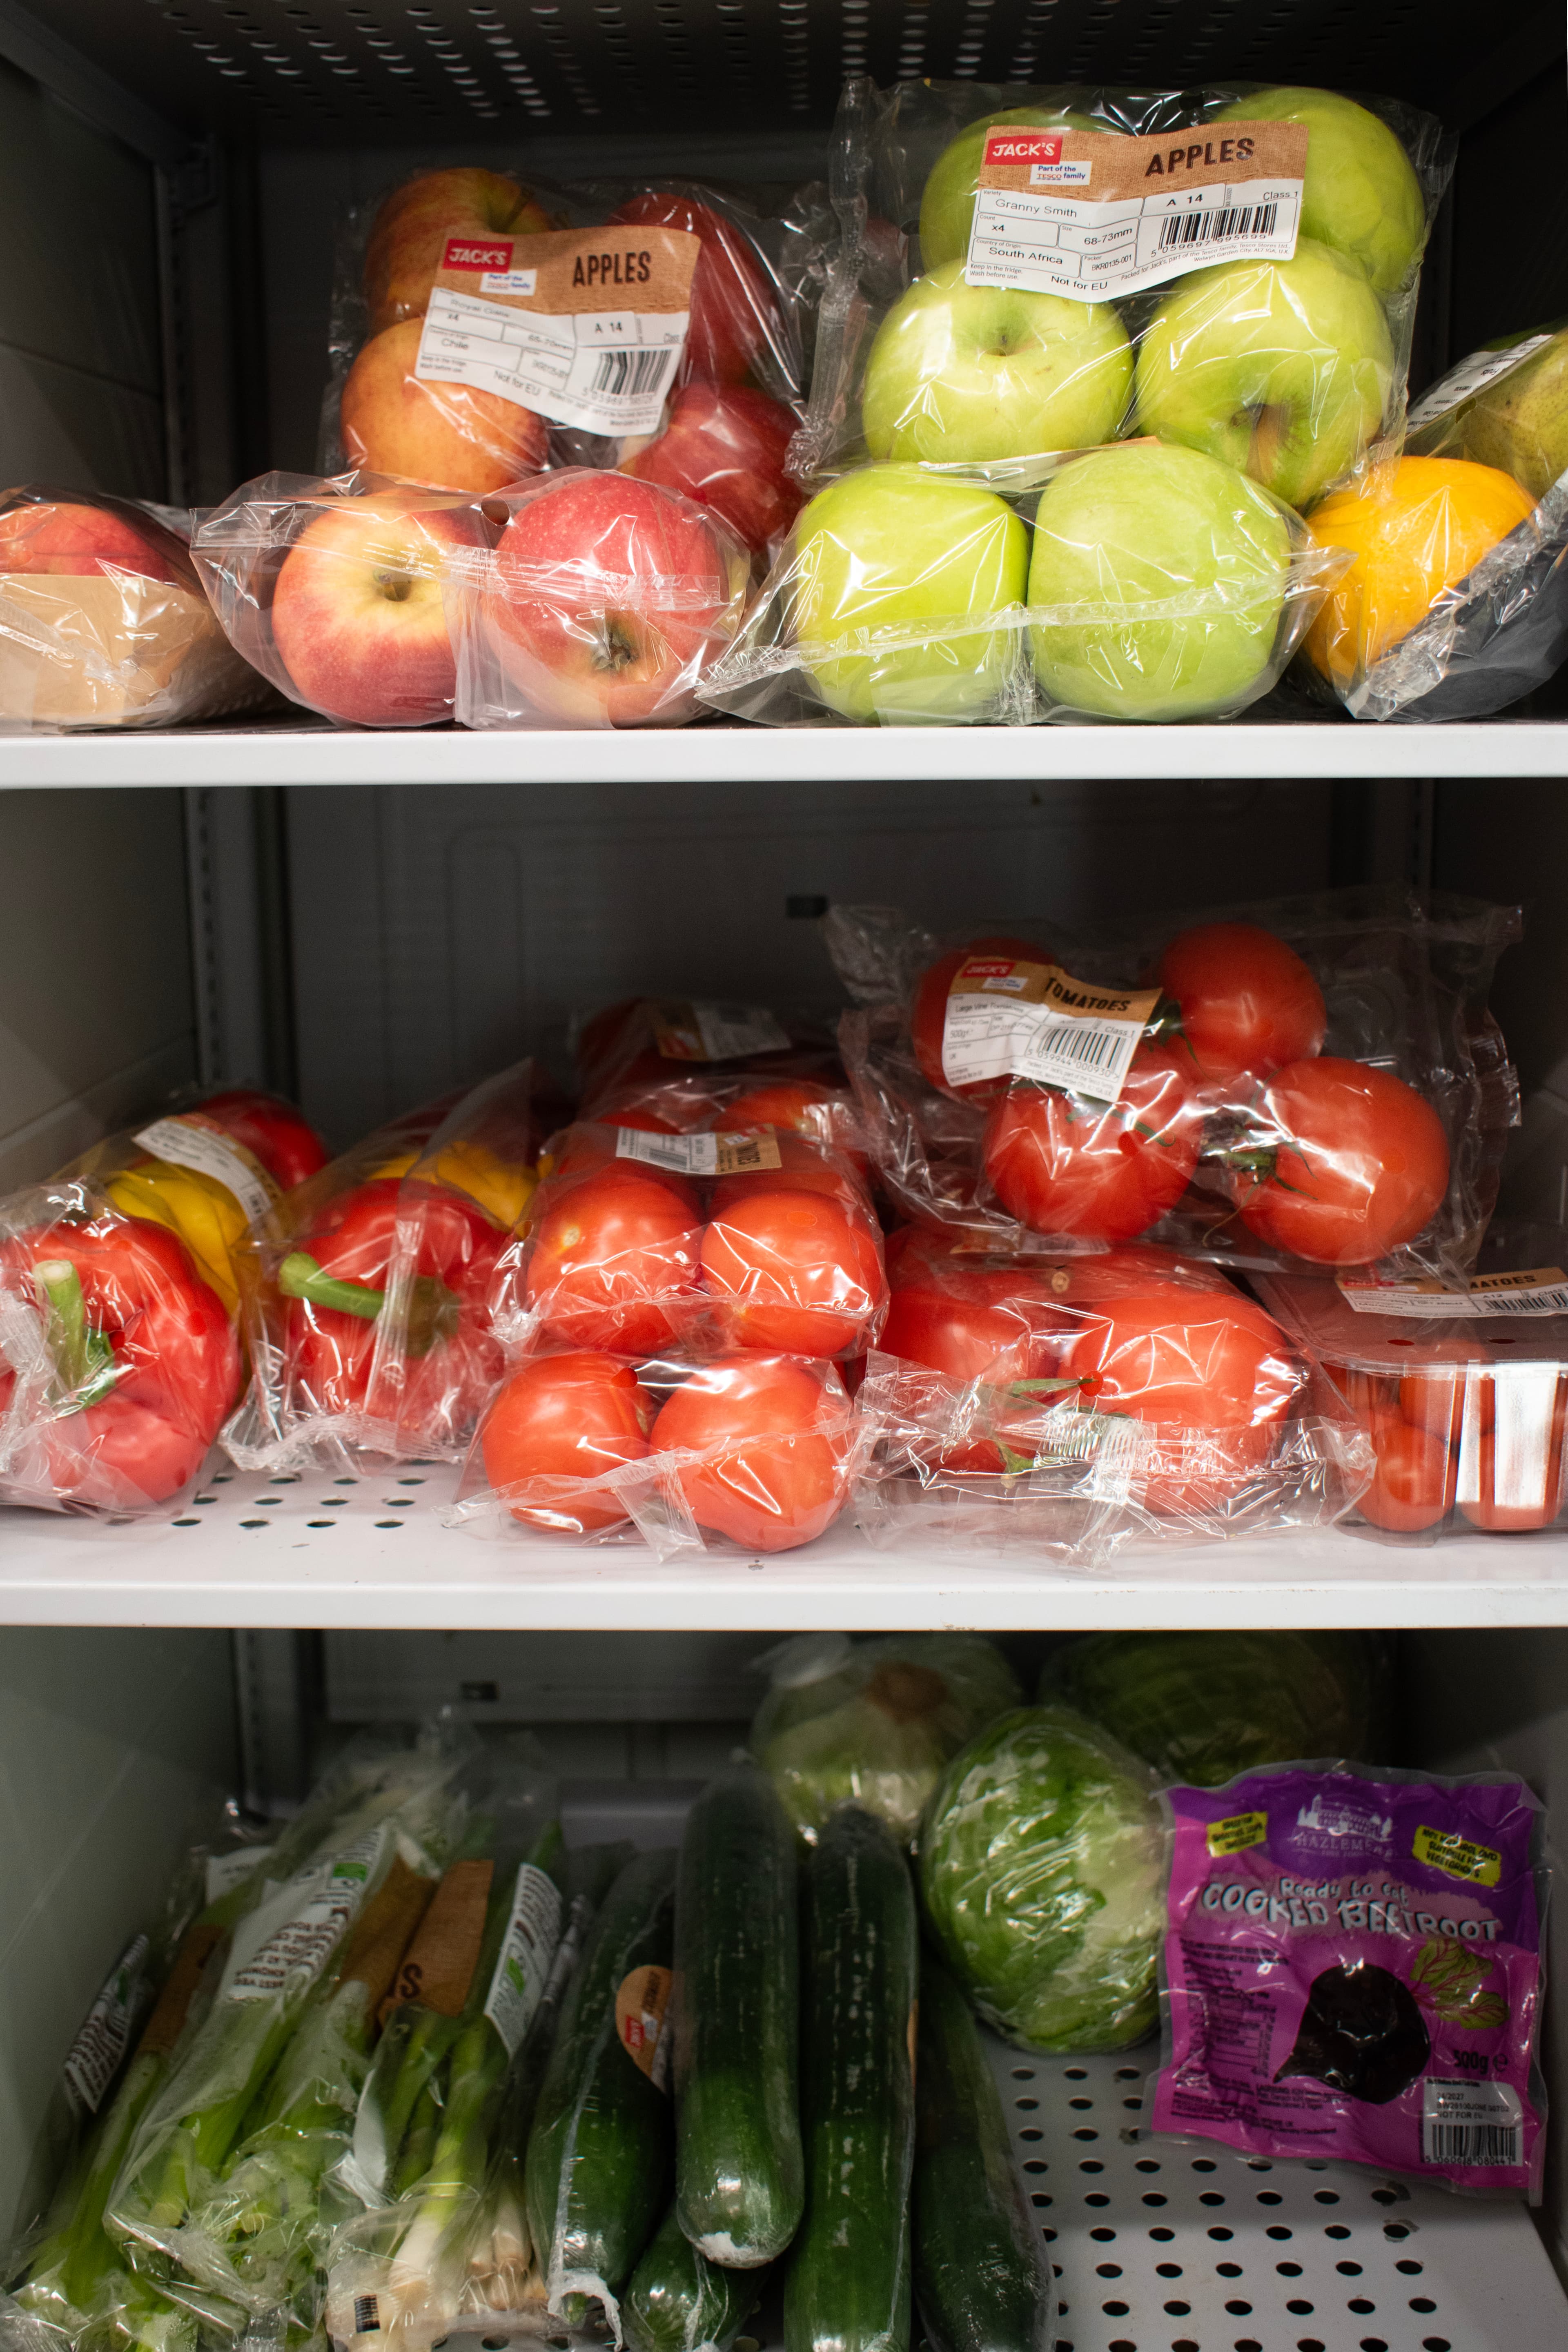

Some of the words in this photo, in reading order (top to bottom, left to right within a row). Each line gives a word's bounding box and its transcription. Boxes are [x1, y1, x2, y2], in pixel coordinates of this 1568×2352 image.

[992, 143, 1055, 156] JACK'S
[1145, 138, 1254, 176] APPLES
[1187, 194, 1203, 204] 14
[1263, 191, 1290, 201] Class
[996, 199, 1040, 214] Granny
[1044, 206, 1077, 218] Smith
[1084, 228, 1132, 245] 68-73mm
[1151, 249, 1156, 258] 5
[1162, 240, 1211, 254] 059697
[1217, 234, 1266, 244] 995699
[449, 248, 507, 265] JACK'S
[989, 247, 1024, 258] South
[1028, 253, 1063, 265] Africa
[1194, 254, 1215, 262] Welwyn
[1217, 249, 1238, 258] Garden
[573, 251, 651, 287] APPLES
[1004, 266, 1023, 274] fridge.
[1121, 270, 1140, 281] Packed
[1150, 259, 1167, 270] Jack's,
[1169, 255, 1180, 264] part
[1051, 276, 1070, 286] Not
[1074, 281, 1088, 290] for
[1091, 281, 1108, 291] EU
[595, 323, 603, 333] A
[610, 321, 622, 332] 14
[1045, 977, 1131, 1011] TOMATOES
[1105, 1026, 1127, 1036] Class
[1280, 1878, 1341, 1898] Ready
[1351, 1881, 1373, 1898] to
[1203, 1882, 1329, 1927] COOKED
[1337, 1899, 1499, 1941] BEETROOT
[1453, 2049, 1488, 2074] 500g
